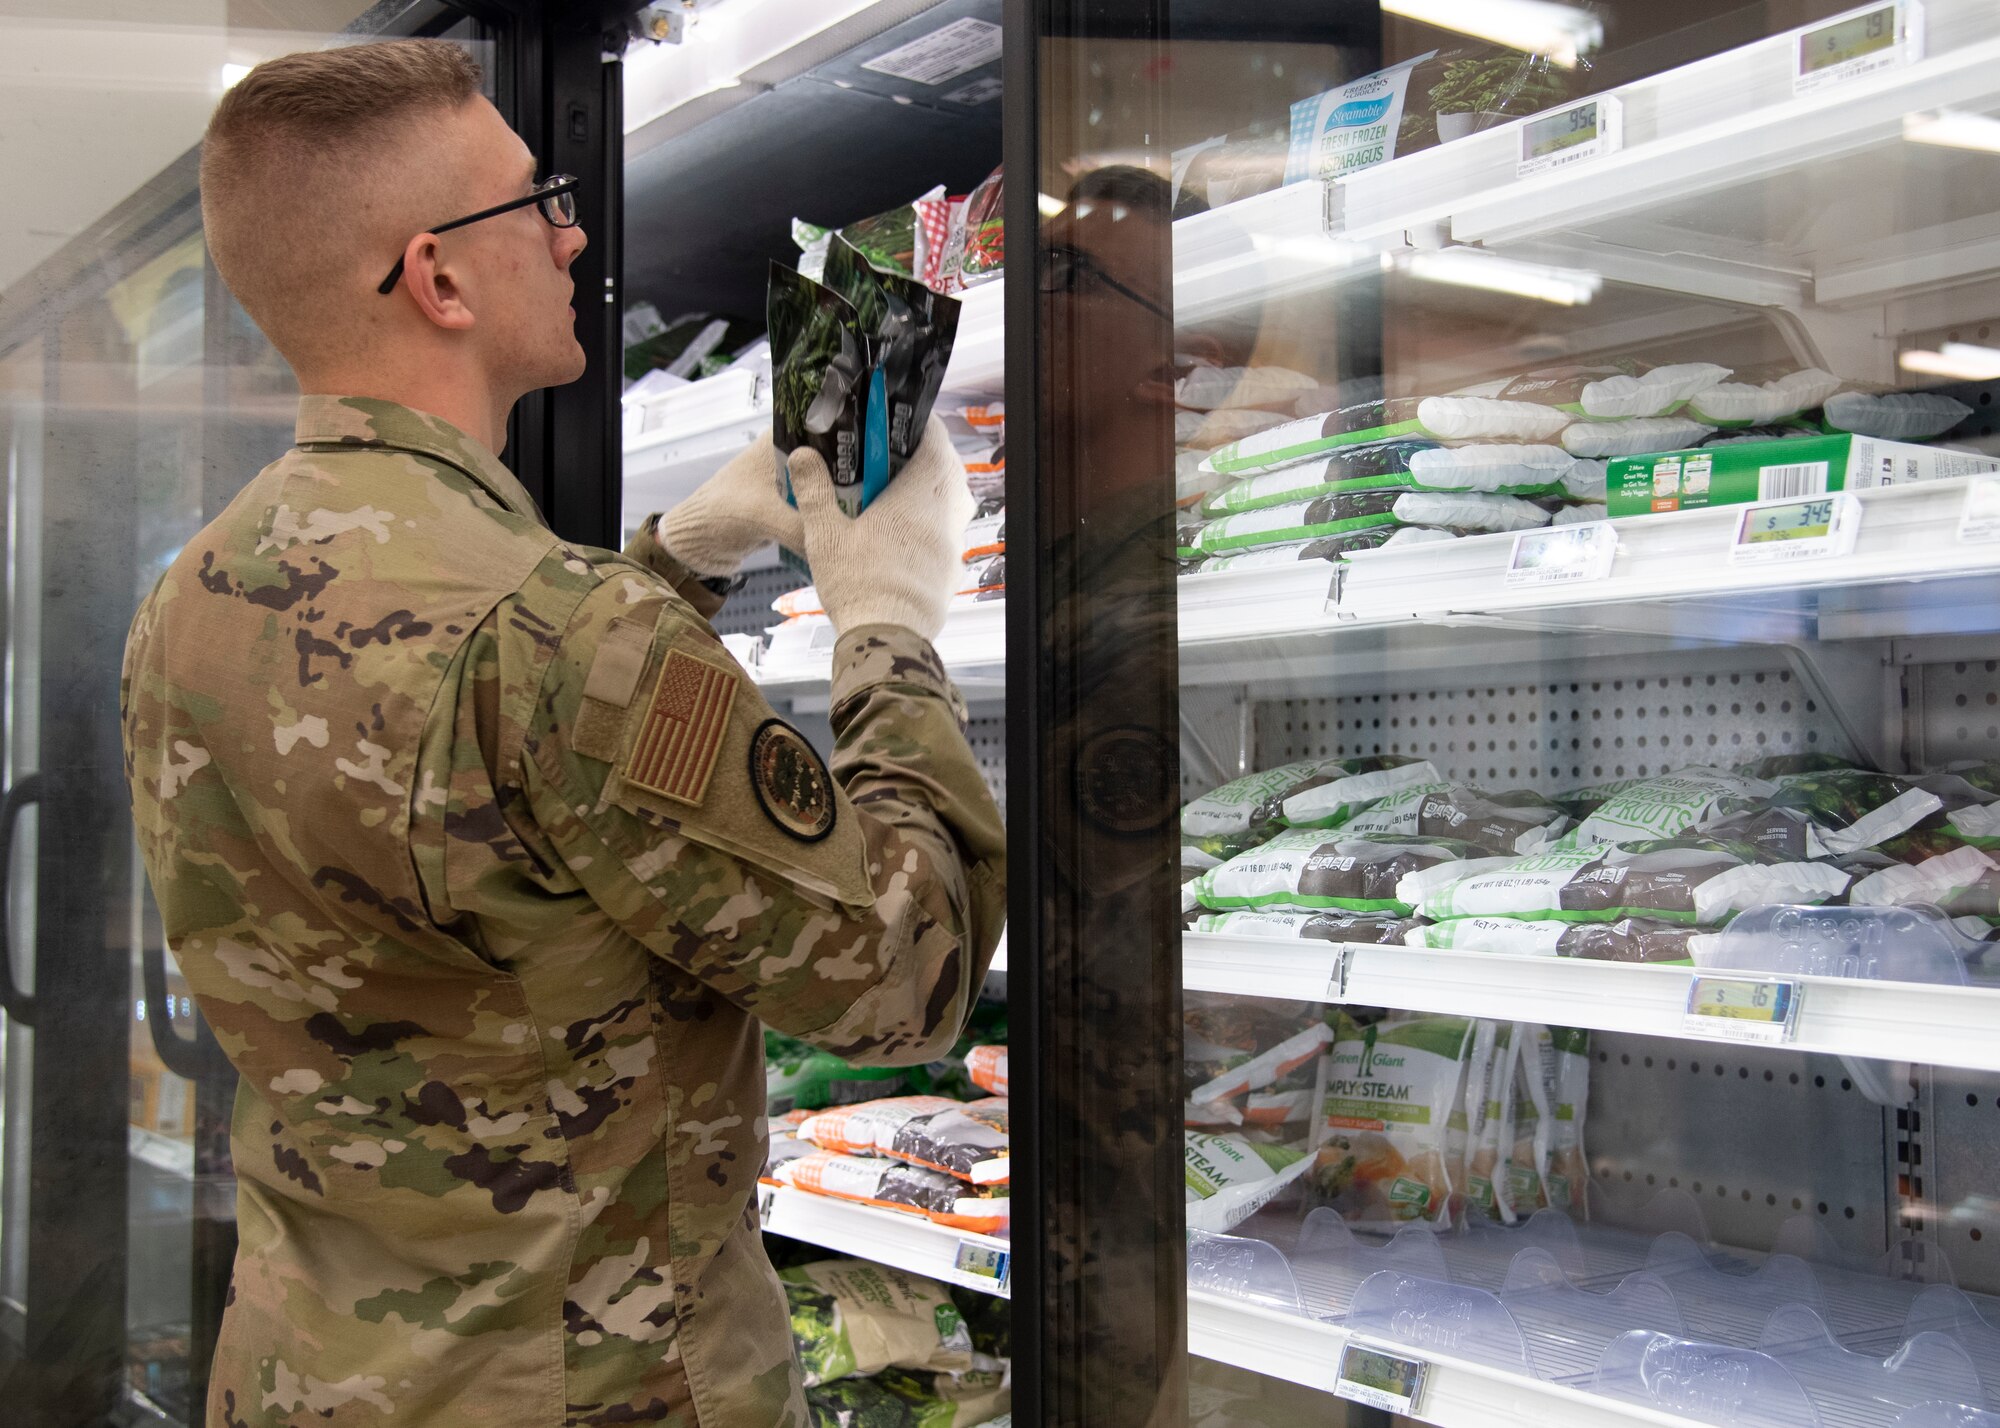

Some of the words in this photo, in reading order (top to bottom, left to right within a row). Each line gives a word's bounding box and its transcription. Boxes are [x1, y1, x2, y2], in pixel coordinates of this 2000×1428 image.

[1332, 104, 1383, 124] Steamable
[1321, 132, 1350, 151] FRESH
[1352, 124, 1388, 144] FROZEN
[1319, 146, 1384, 175] ASPARAGUS
[1768, 516, 1776, 530] $
[1593, 798, 1693, 837] SPROUTS
[1757, 832, 1788, 841] SUGGESTION
[1249, 864, 1258, 873] 16
[1770, 907, 1884, 945] Green
[1372, 1053, 1407, 1067] Giant
[1362, 1082, 1409, 1101] STEAM
[1211, 1136, 1245, 1162] Giant
[1185, 1146, 1230, 1187] STEAM
